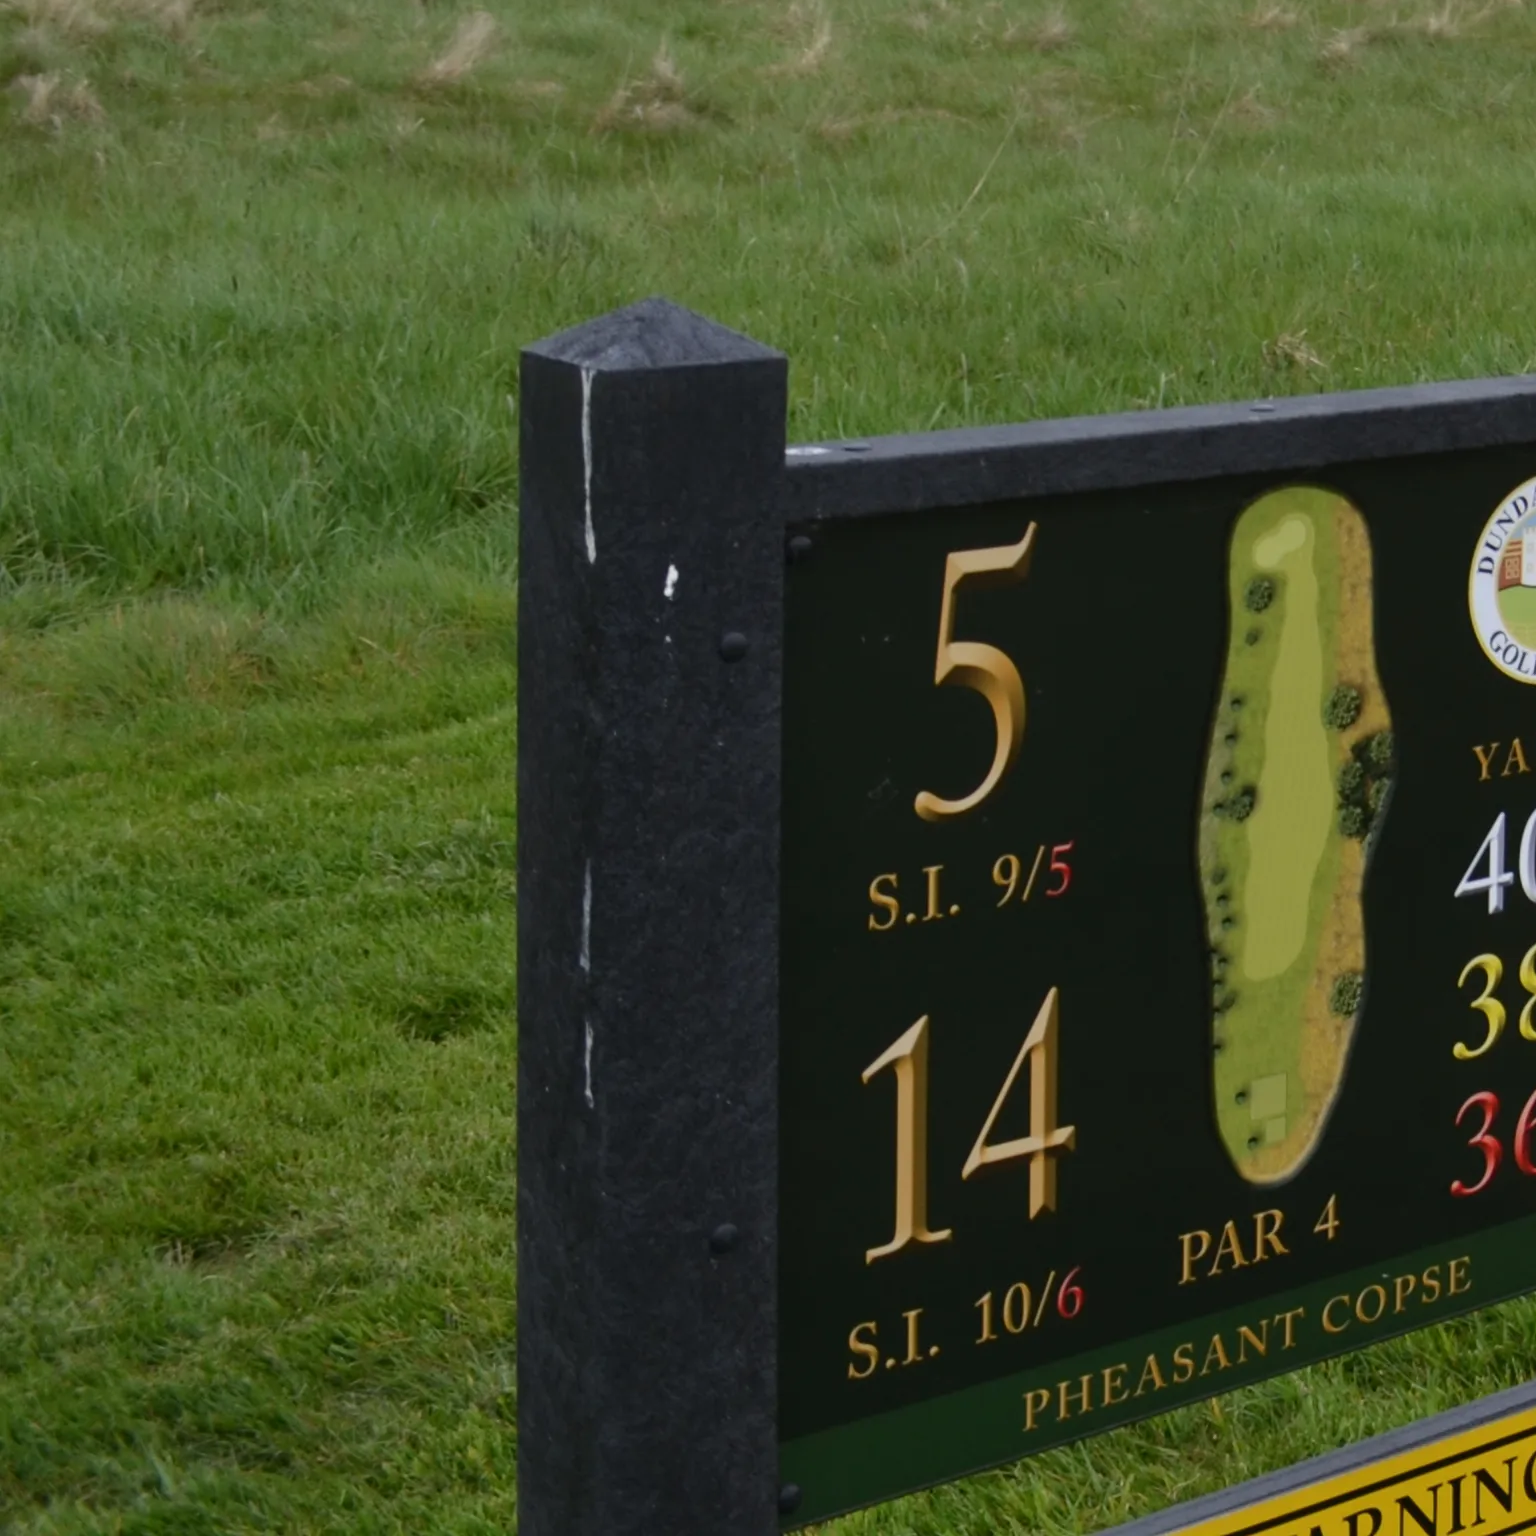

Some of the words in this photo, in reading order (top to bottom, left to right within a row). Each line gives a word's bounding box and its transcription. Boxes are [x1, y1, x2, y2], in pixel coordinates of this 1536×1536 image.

[914, 521, 1037, 822] 5
[868, 865, 961, 931] S.I.
[992, 841, 1075, 908] 9/5
[861, 986, 1075, 1265] 14
[1178, 1208, 1290, 1285] PAR
[1314, 1194, 1340, 1240] 4
[848, 1308, 940, 1380] S.I.
[974, 1266, 1085, 1344] 10/6
[1022, 1308, 1304, 1432] PHEASANT
[1321, 1256, 1473, 1334] COPSE
